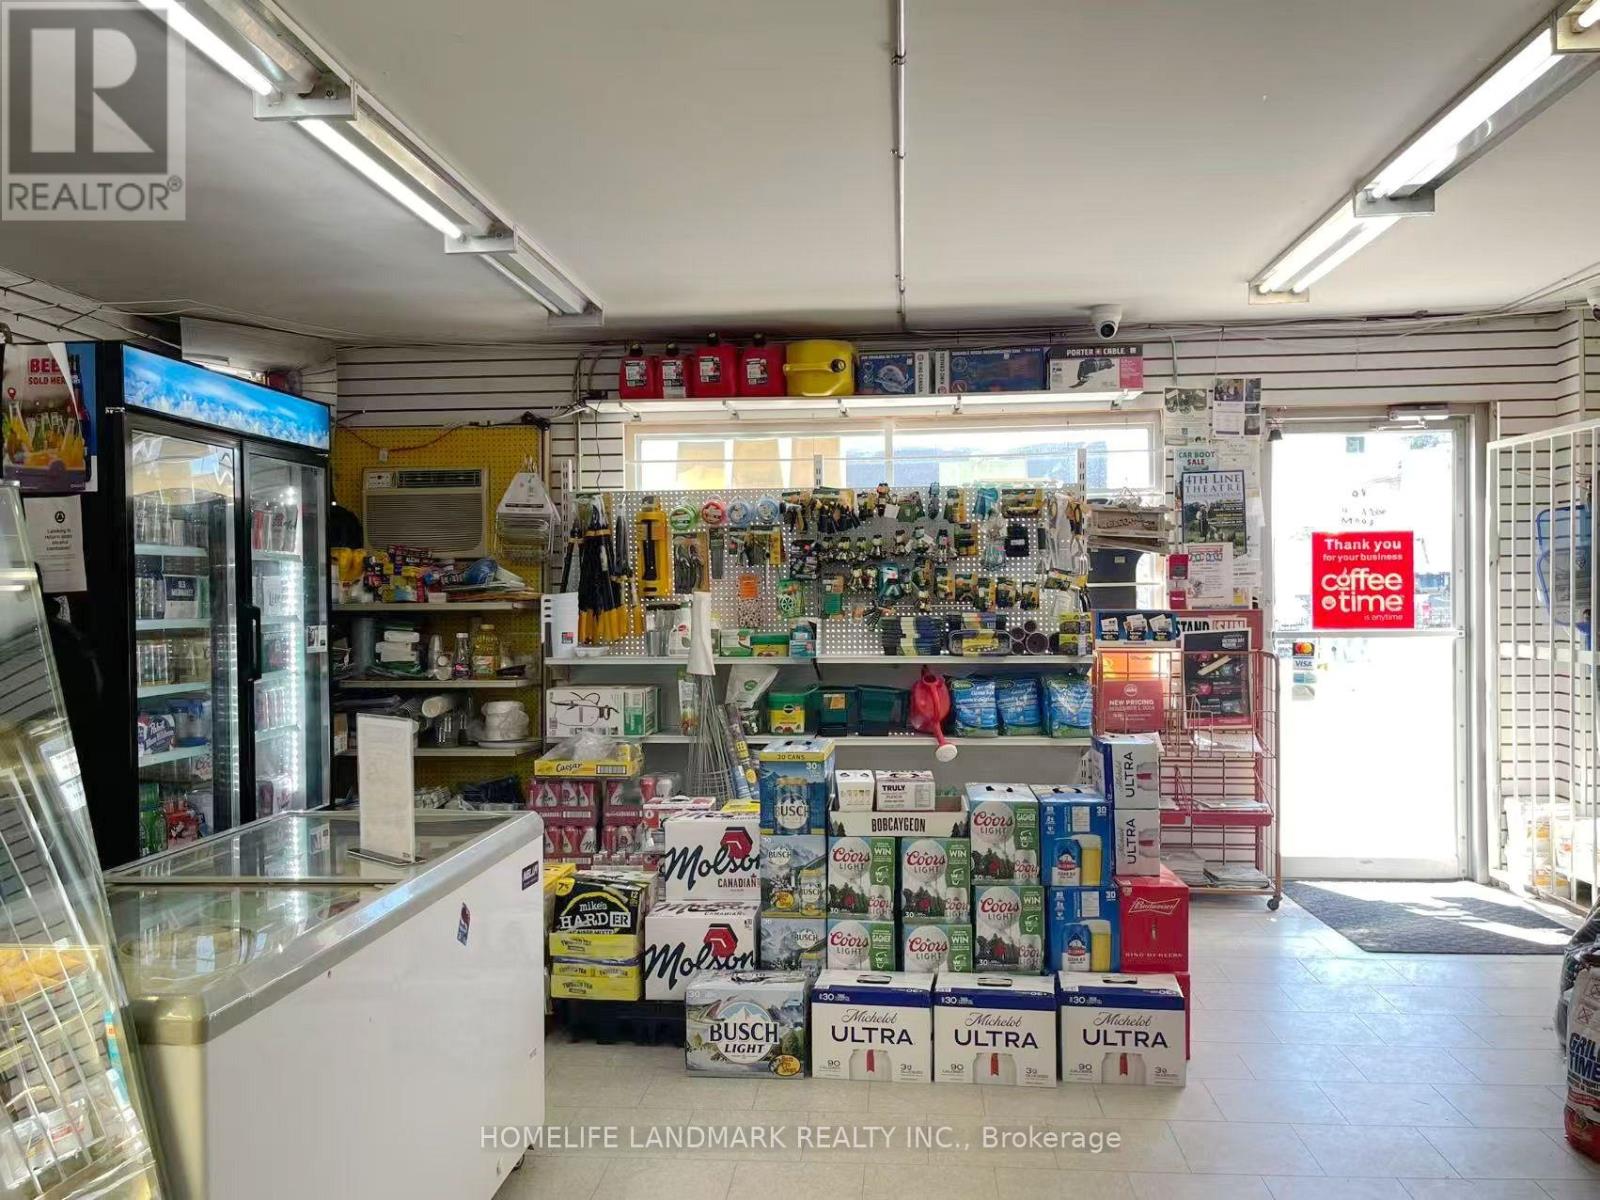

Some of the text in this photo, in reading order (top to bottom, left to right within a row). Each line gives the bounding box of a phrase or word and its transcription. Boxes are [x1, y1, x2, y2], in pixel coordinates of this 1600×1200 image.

[1066, 347, 1126, 357] PORTER CABLE
[30, 358, 60, 373] BEE
[28, 376, 66, 385] SOLD HER
[1185, 473, 1241, 485] 4TH LINE
[1324, 537, 1402, 552] Thank you
[1322, 553, 1336, 561] for
[1360, 553, 1403, 561] business
[1321, 567, 1403, 592] coffee
[1338, 591, 1403, 613] time
[1372, 613, 1403, 622] anytime
[556, 763, 583, 773] Caesar
[806, 762, 818, 770] 30
[1124, 752, 1135, 798] ULTRA
[871, 817, 926, 833] BOBCAYGEON
[974, 811, 1013, 827] Coors
[1126, 818, 1137, 865] ULTRA
[833, 847, 871, 863] Coors
[874, 847, 892, 855] WIN
[906, 850, 946, 866] Coors
[949, 850, 967, 858] WIN
[717, 877, 757, 888] CANADIAN
[1023, 895, 1041, 905] WIN
[1105, 890, 1116, 899] 30
[981, 897, 1019, 913] Coors
[987, 913, 1014, 921] LIGHT
[830, 931, 869, 947] Coors
[908, 937, 948, 953] Coors
[836, 948, 863, 956] LIGHT
[916, 952, 944, 960] LIGHT
[965, 1012, 1022, 1027] Michelob
[1093, 1012, 1153, 1027] Michelob
[710, 1022, 778, 1043] BUSCH
[831, 1025, 914, 1046] ULTRA
[954, 1029, 1039, 1049] ULTRA
[1083, 1029, 1169, 1049] ULTRA
[724, 1044, 766, 1054] LIGHT
[1569, 1032, 1600, 1063] GRIL
[950, 1063, 964, 1071] 90
[1079, 1063, 1093, 1071] 90
